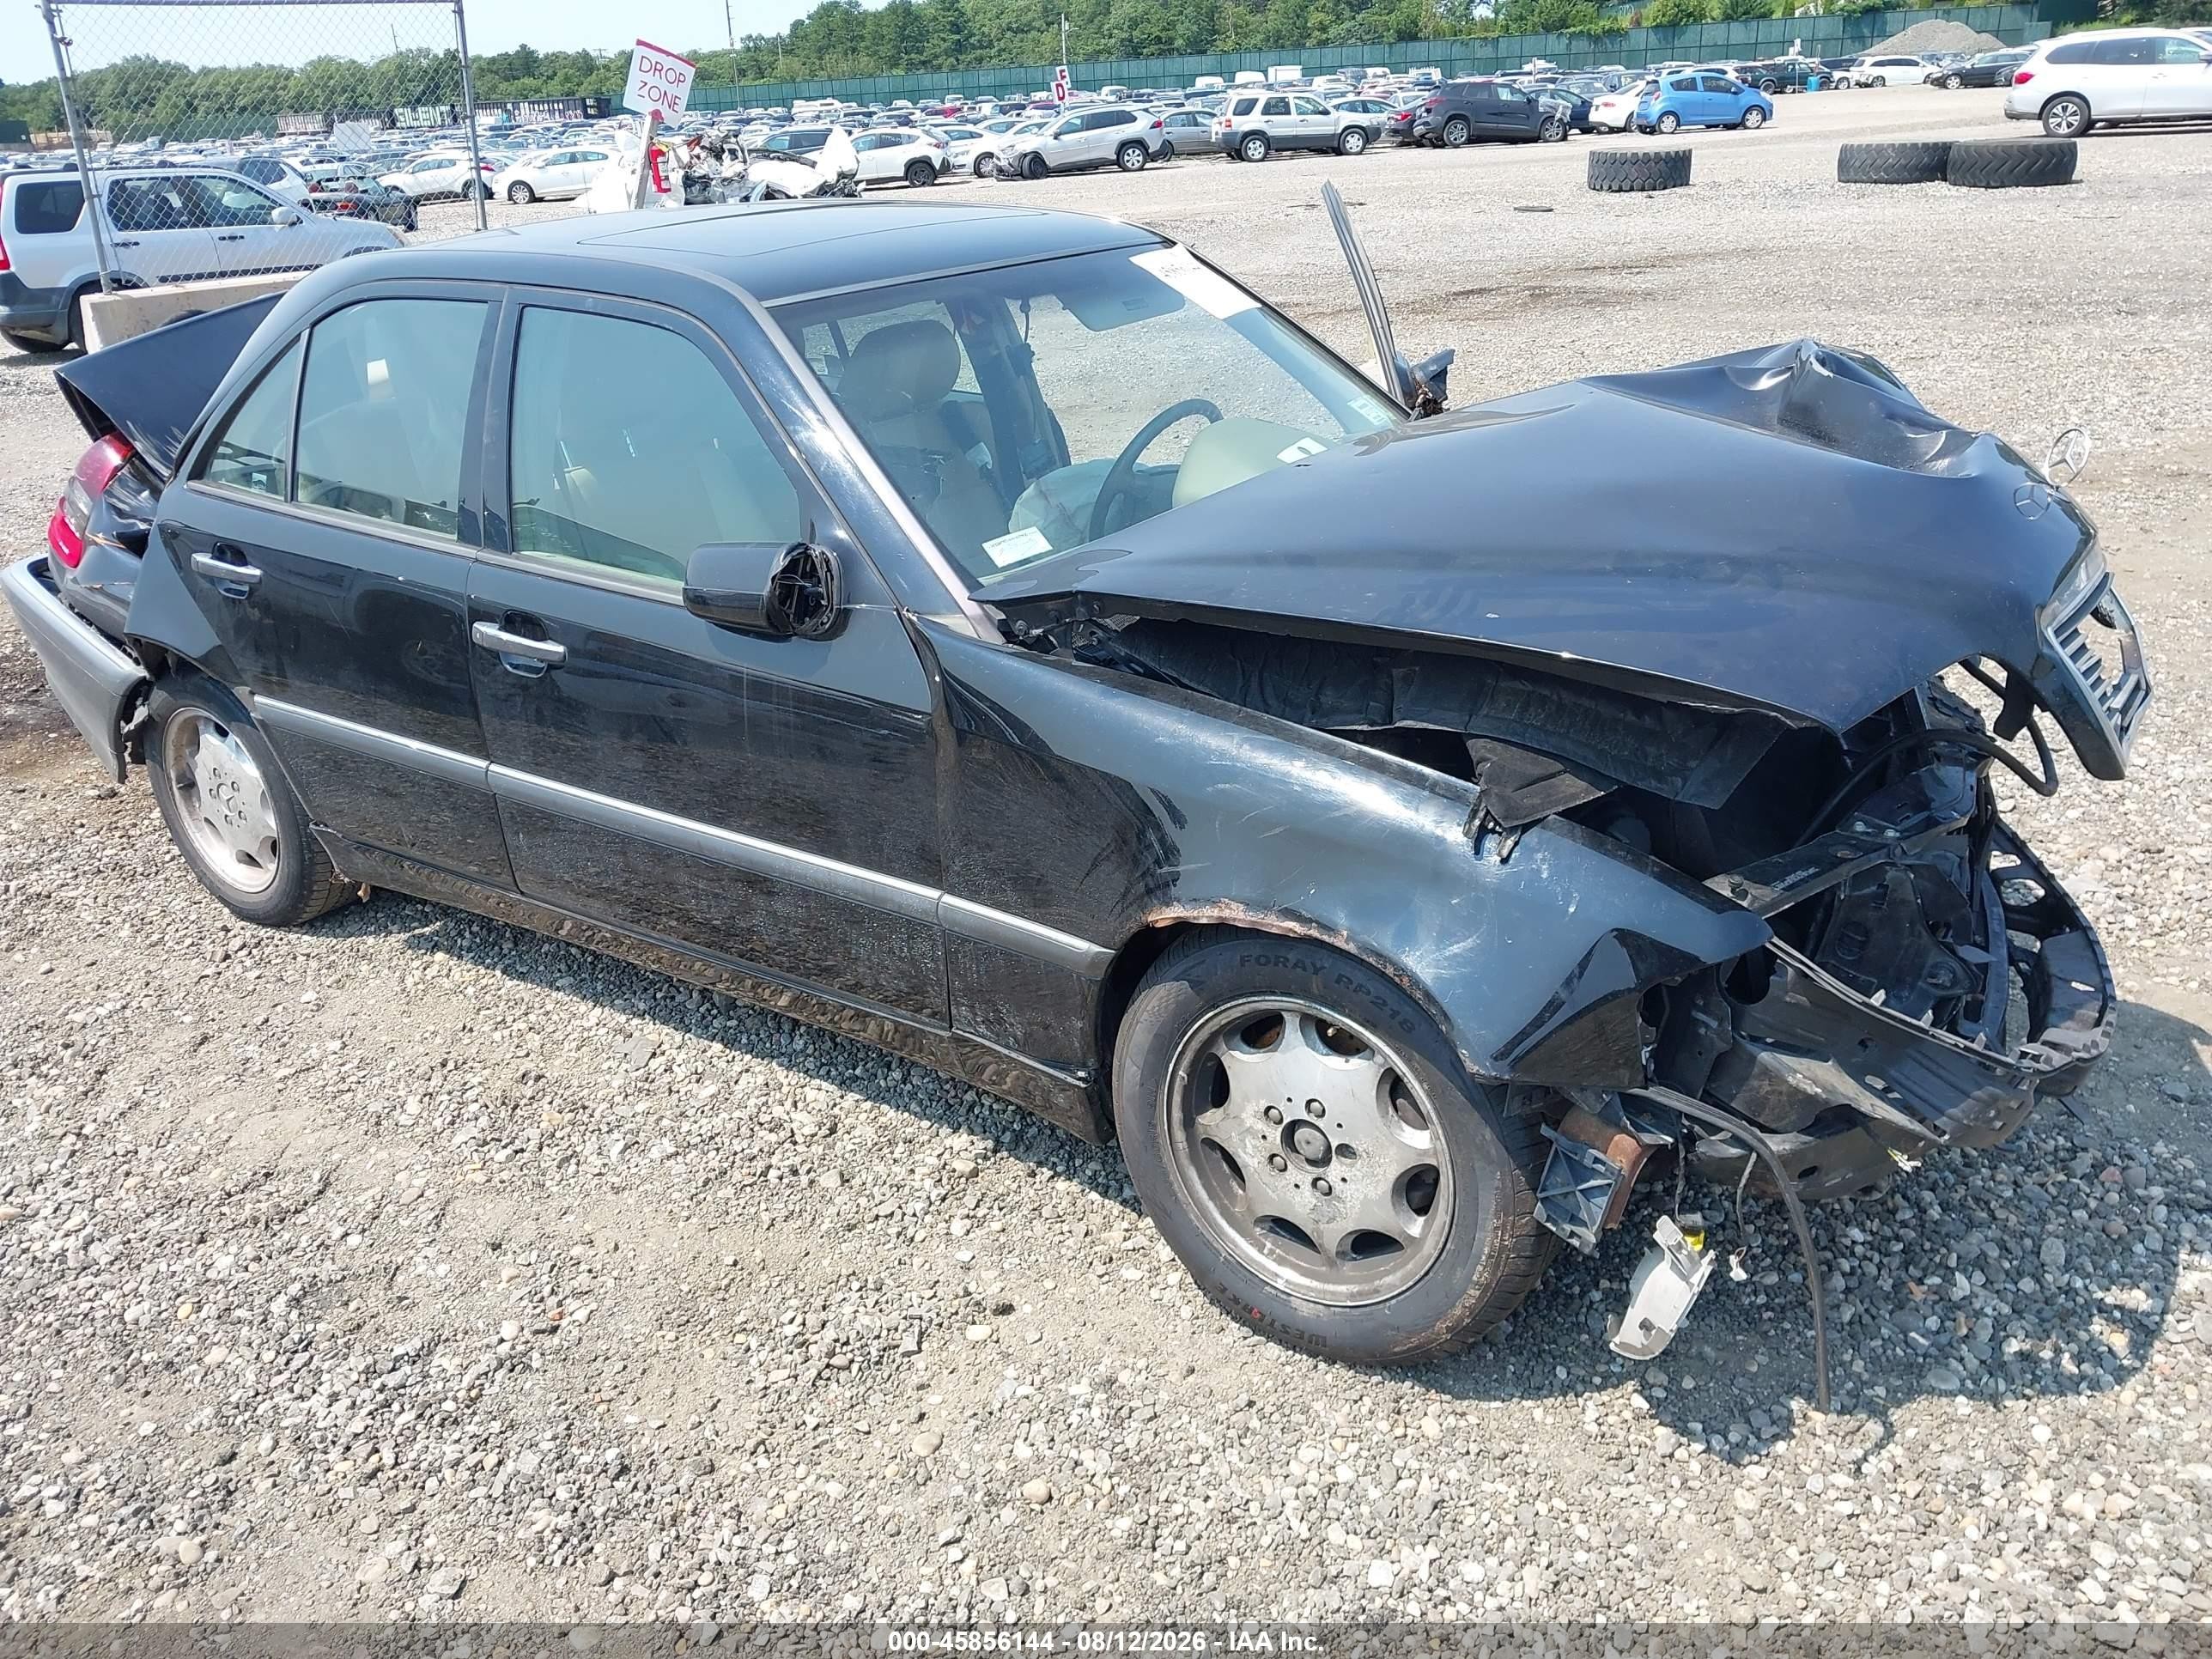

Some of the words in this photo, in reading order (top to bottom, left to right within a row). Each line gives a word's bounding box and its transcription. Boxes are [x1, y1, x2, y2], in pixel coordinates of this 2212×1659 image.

[639, 55, 686, 88] DROP
[637, 80, 681, 113] ZONE
[1055, 82, 1066, 101] D
[1239, 954, 1328, 976] FORAY
[1334, 973, 1416, 1034] RP218
